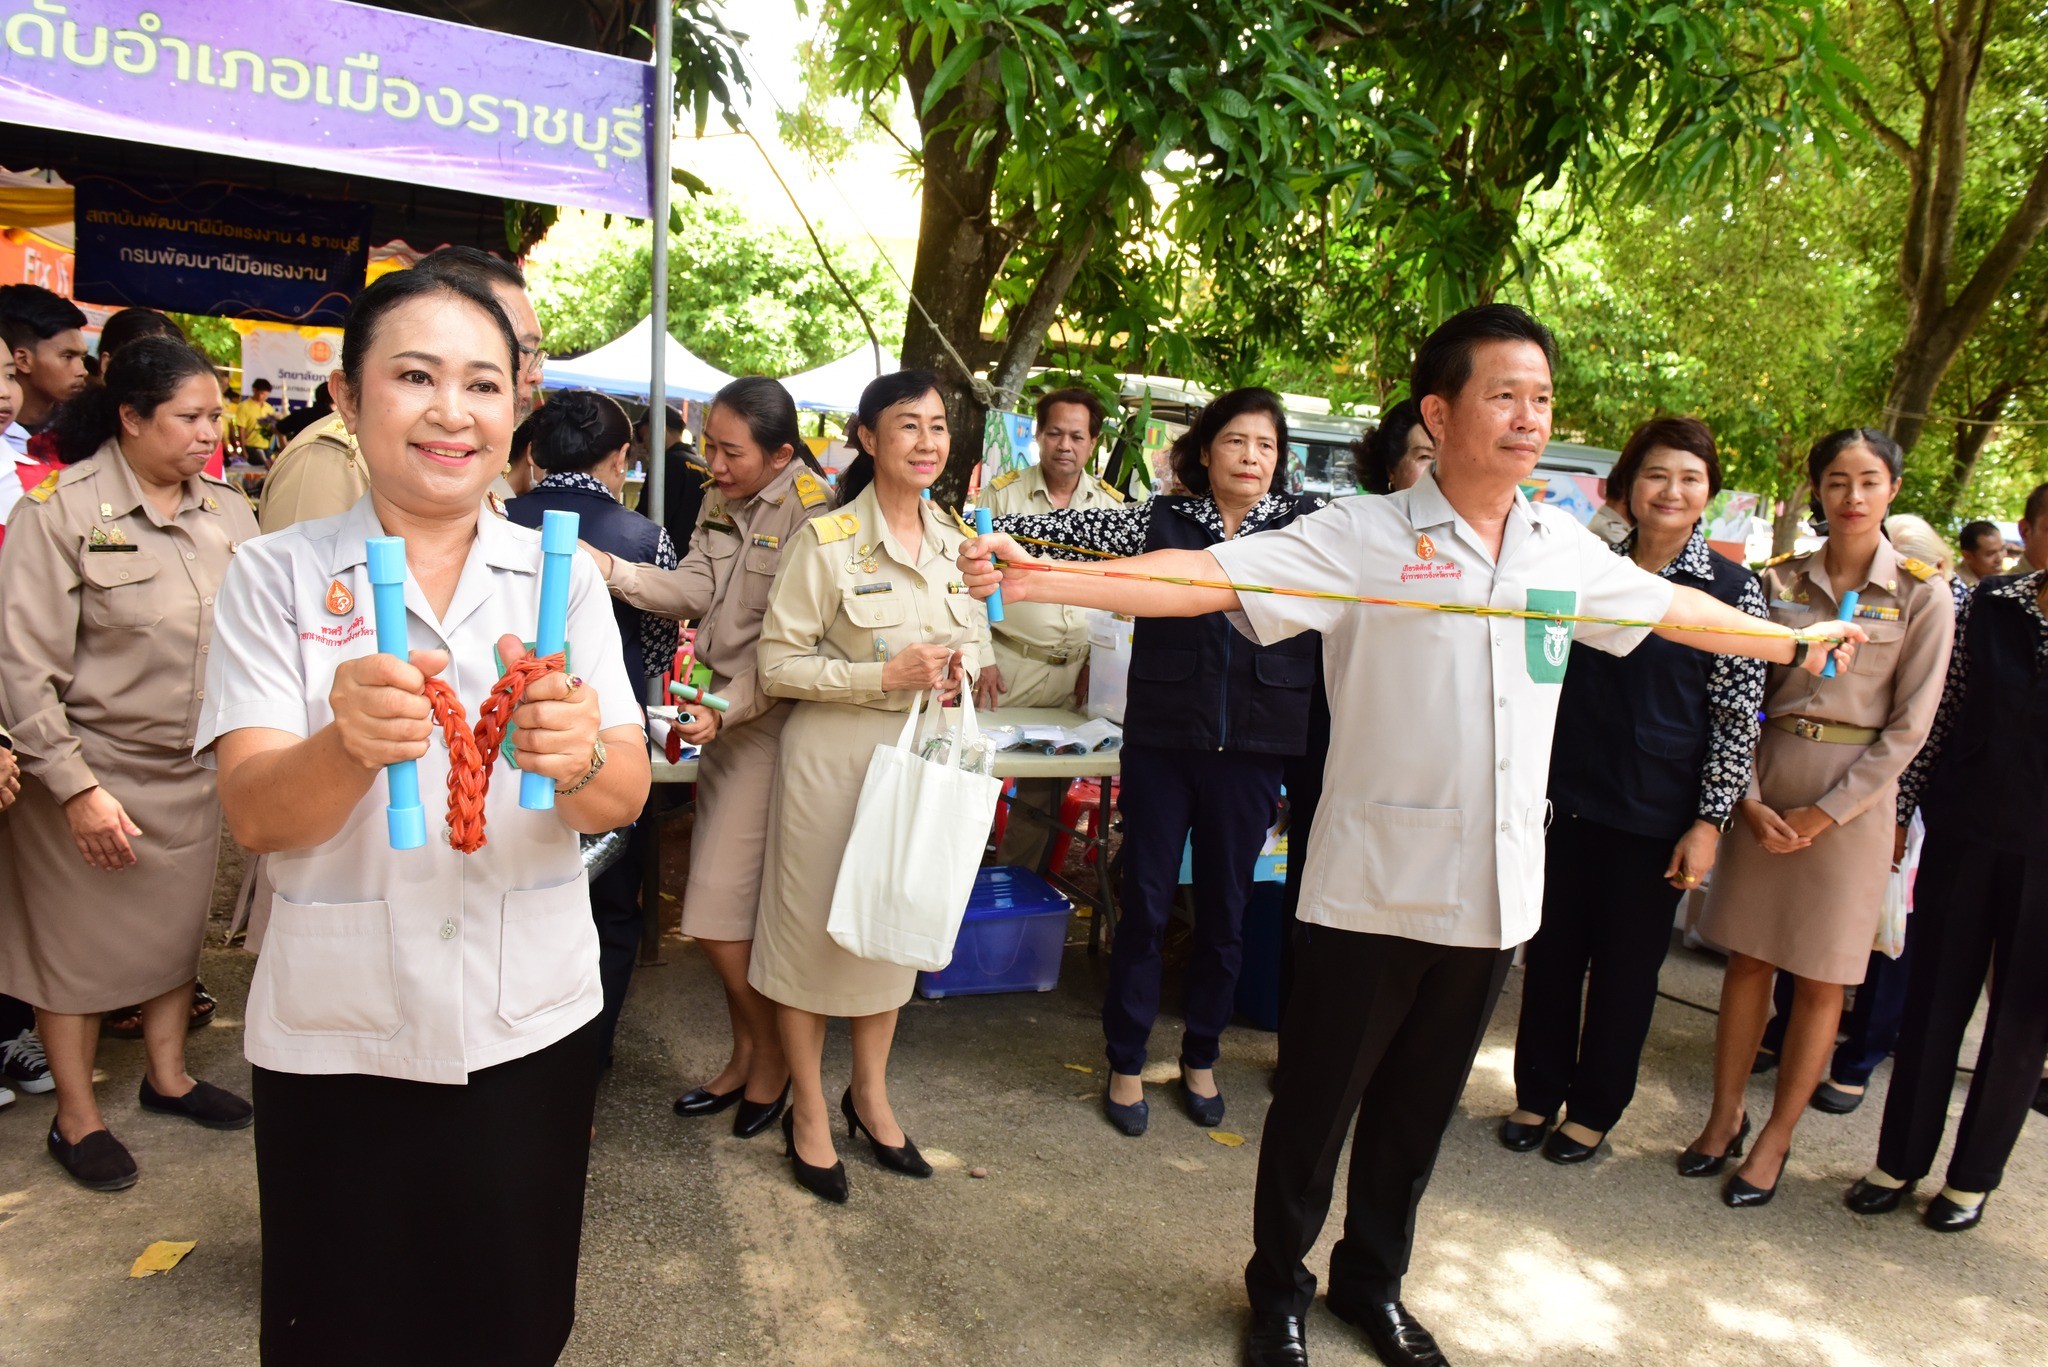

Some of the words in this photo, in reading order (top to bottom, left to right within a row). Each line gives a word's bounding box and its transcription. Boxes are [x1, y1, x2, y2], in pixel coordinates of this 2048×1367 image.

[0, 0, 644, 168] ดับอำเภอเมืองราชบุรี
[85, 207, 292, 244] สถาบันพัฒนาฝีมือแรงงาน
[296, 233, 307, 246] 4
[312, 234, 361, 255] ราชบุรี
[119, 245, 328, 282] กรมพัฒนาฝีมือแรงงาน
[277, 368, 330, 383] วิทยาลัยก
